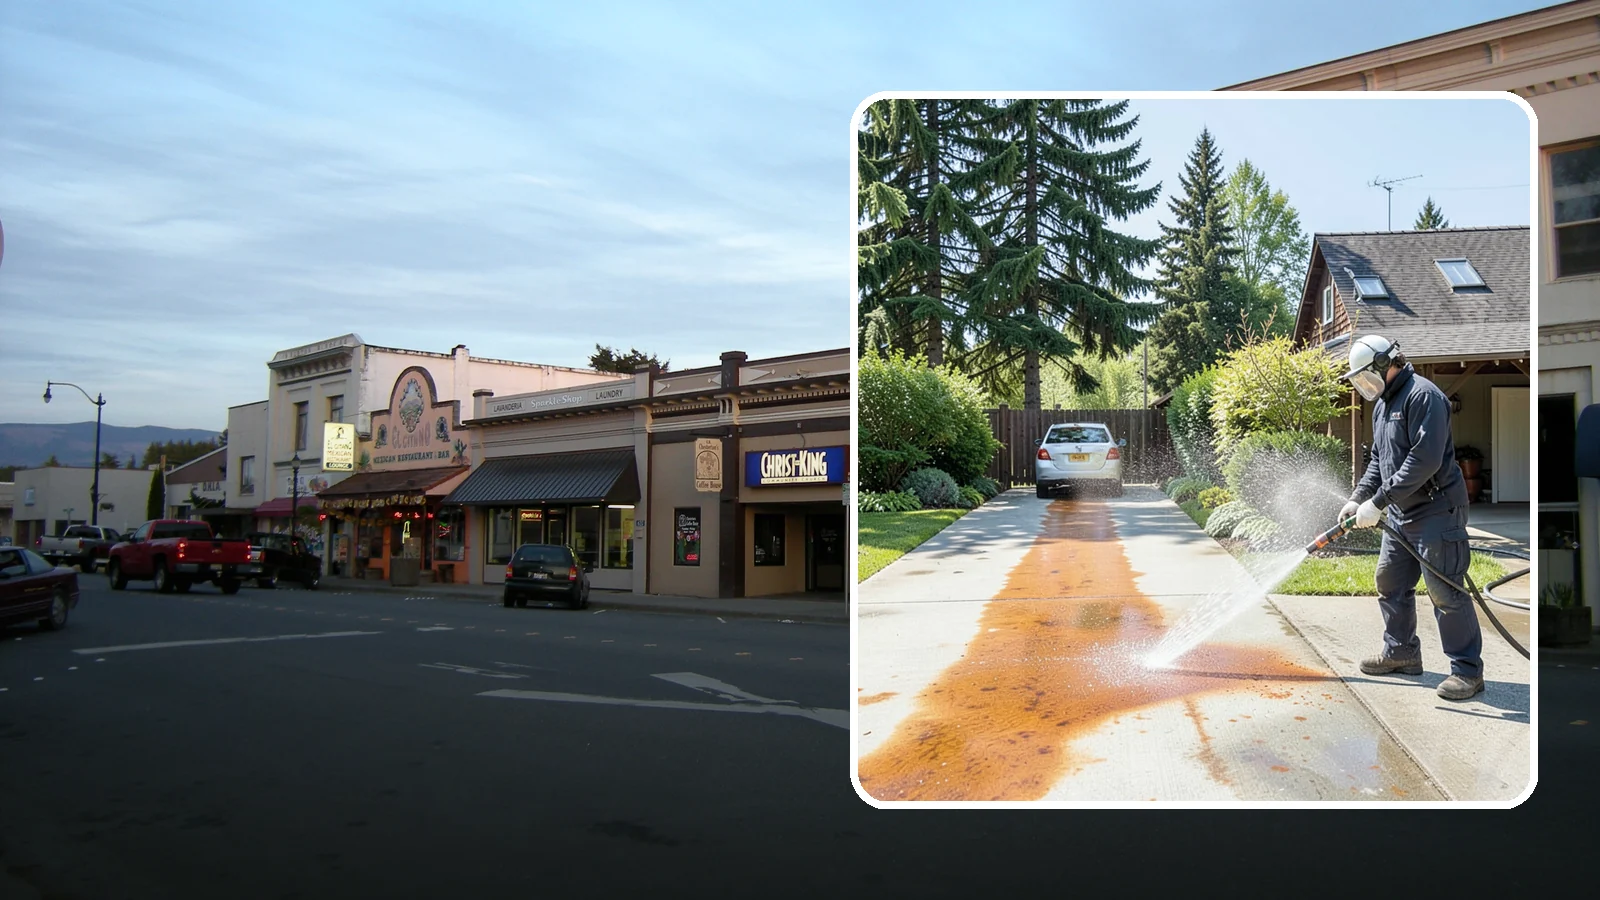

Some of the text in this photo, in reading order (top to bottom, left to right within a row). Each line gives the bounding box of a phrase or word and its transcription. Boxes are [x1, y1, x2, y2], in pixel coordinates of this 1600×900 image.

[562, 394, 583, 405] Shop
[595, 389, 623, 400] LAUNDRY
[493, 402, 522, 412] LAVANDERIA
[397, 451, 434, 462] RESTAURANT
[437, 450, 450, 459] BAR
